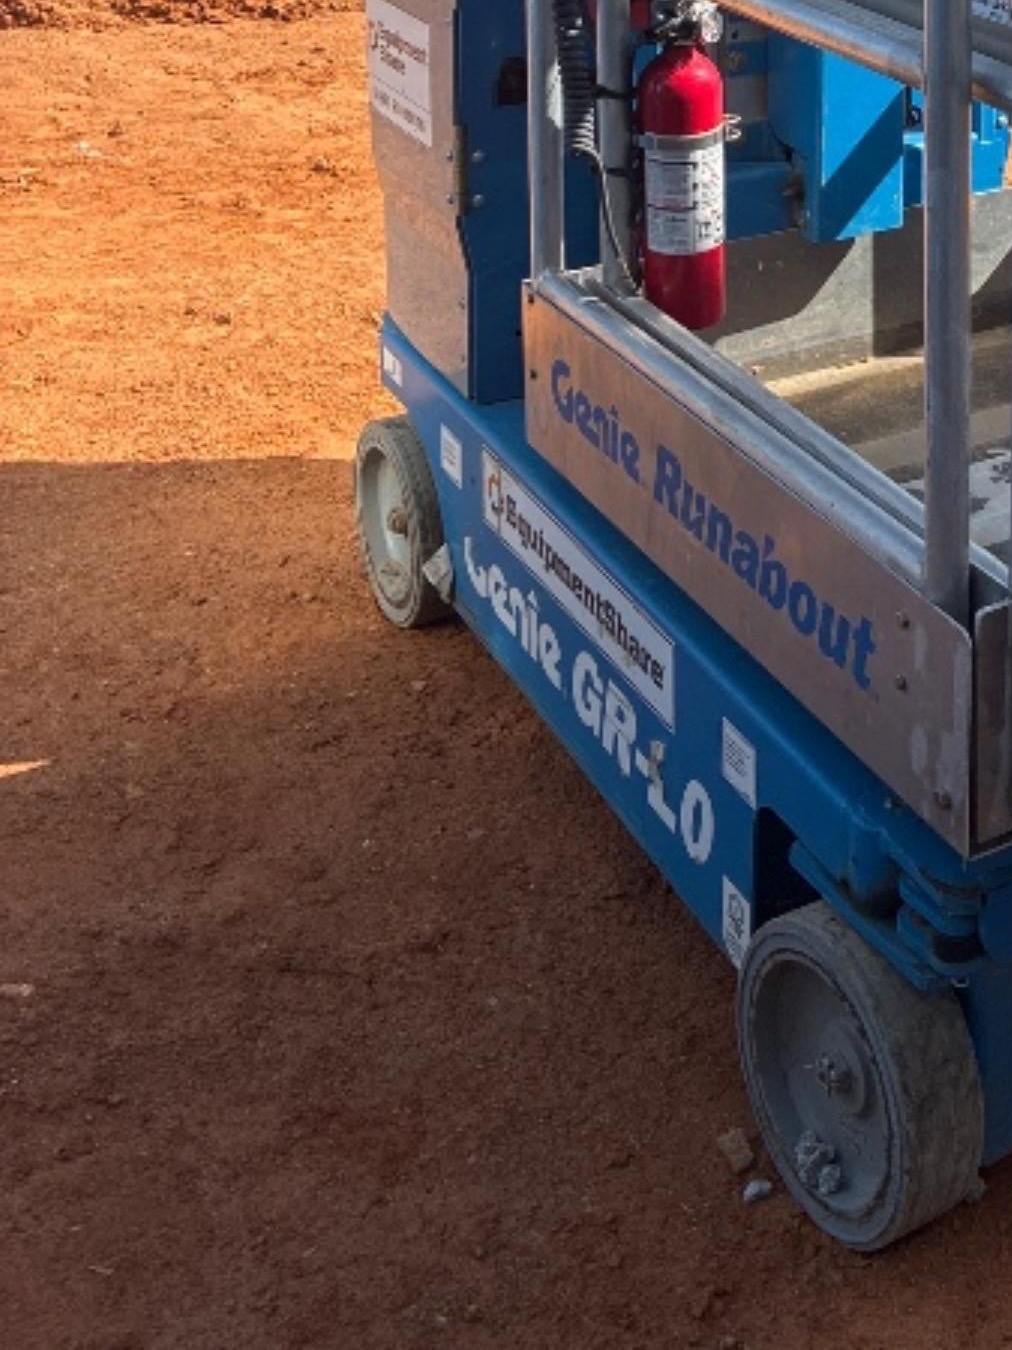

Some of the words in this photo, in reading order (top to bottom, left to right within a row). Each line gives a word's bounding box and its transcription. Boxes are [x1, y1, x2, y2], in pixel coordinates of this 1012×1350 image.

[506, 494, 666, 691] EquipmentShare
[551, 359, 641, 484] Genie
[653, 443, 876, 691] Runabout
